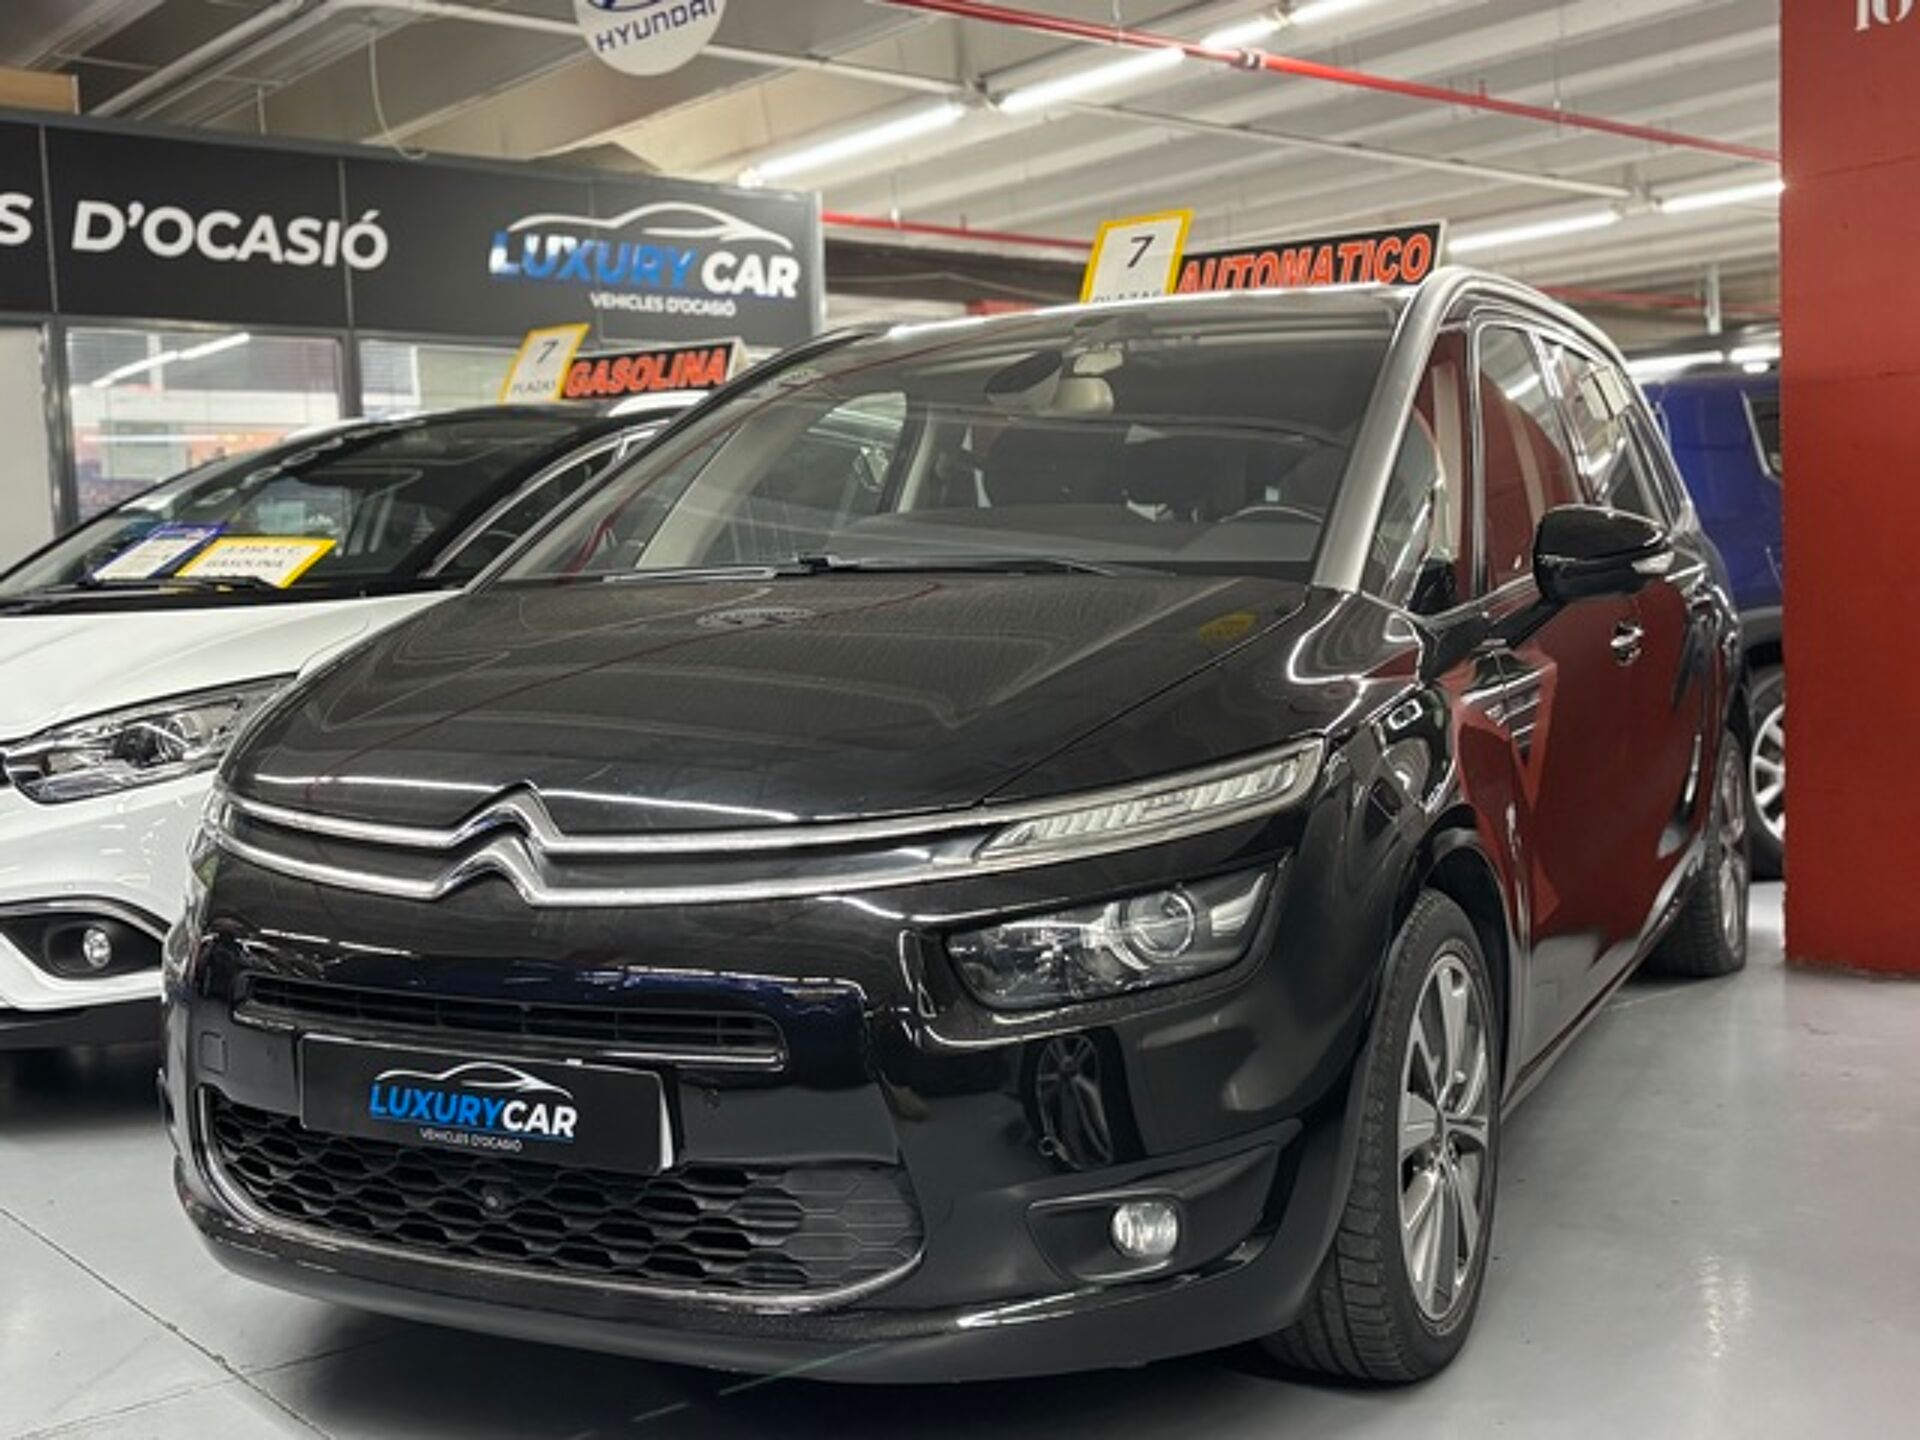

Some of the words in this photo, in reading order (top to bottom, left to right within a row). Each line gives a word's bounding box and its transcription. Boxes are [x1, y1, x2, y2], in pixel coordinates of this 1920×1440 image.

[595, 0, 717, 52] HYUNDAI
[71, 200, 389, 270] D'OCASIÓ
[1127, 234, 1155, 268] 7
[488, 231, 697, 289] LUXURY
[701, 250, 800, 298] CAR
[1177, 232, 1433, 293] AUTOMATICO
[590, 291, 665, 313] VEHICLES
[536, 340, 559, 364] 7
[565, 348, 727, 397] GASOLINA
[419, 1127, 469, 1145] VEHICLES
